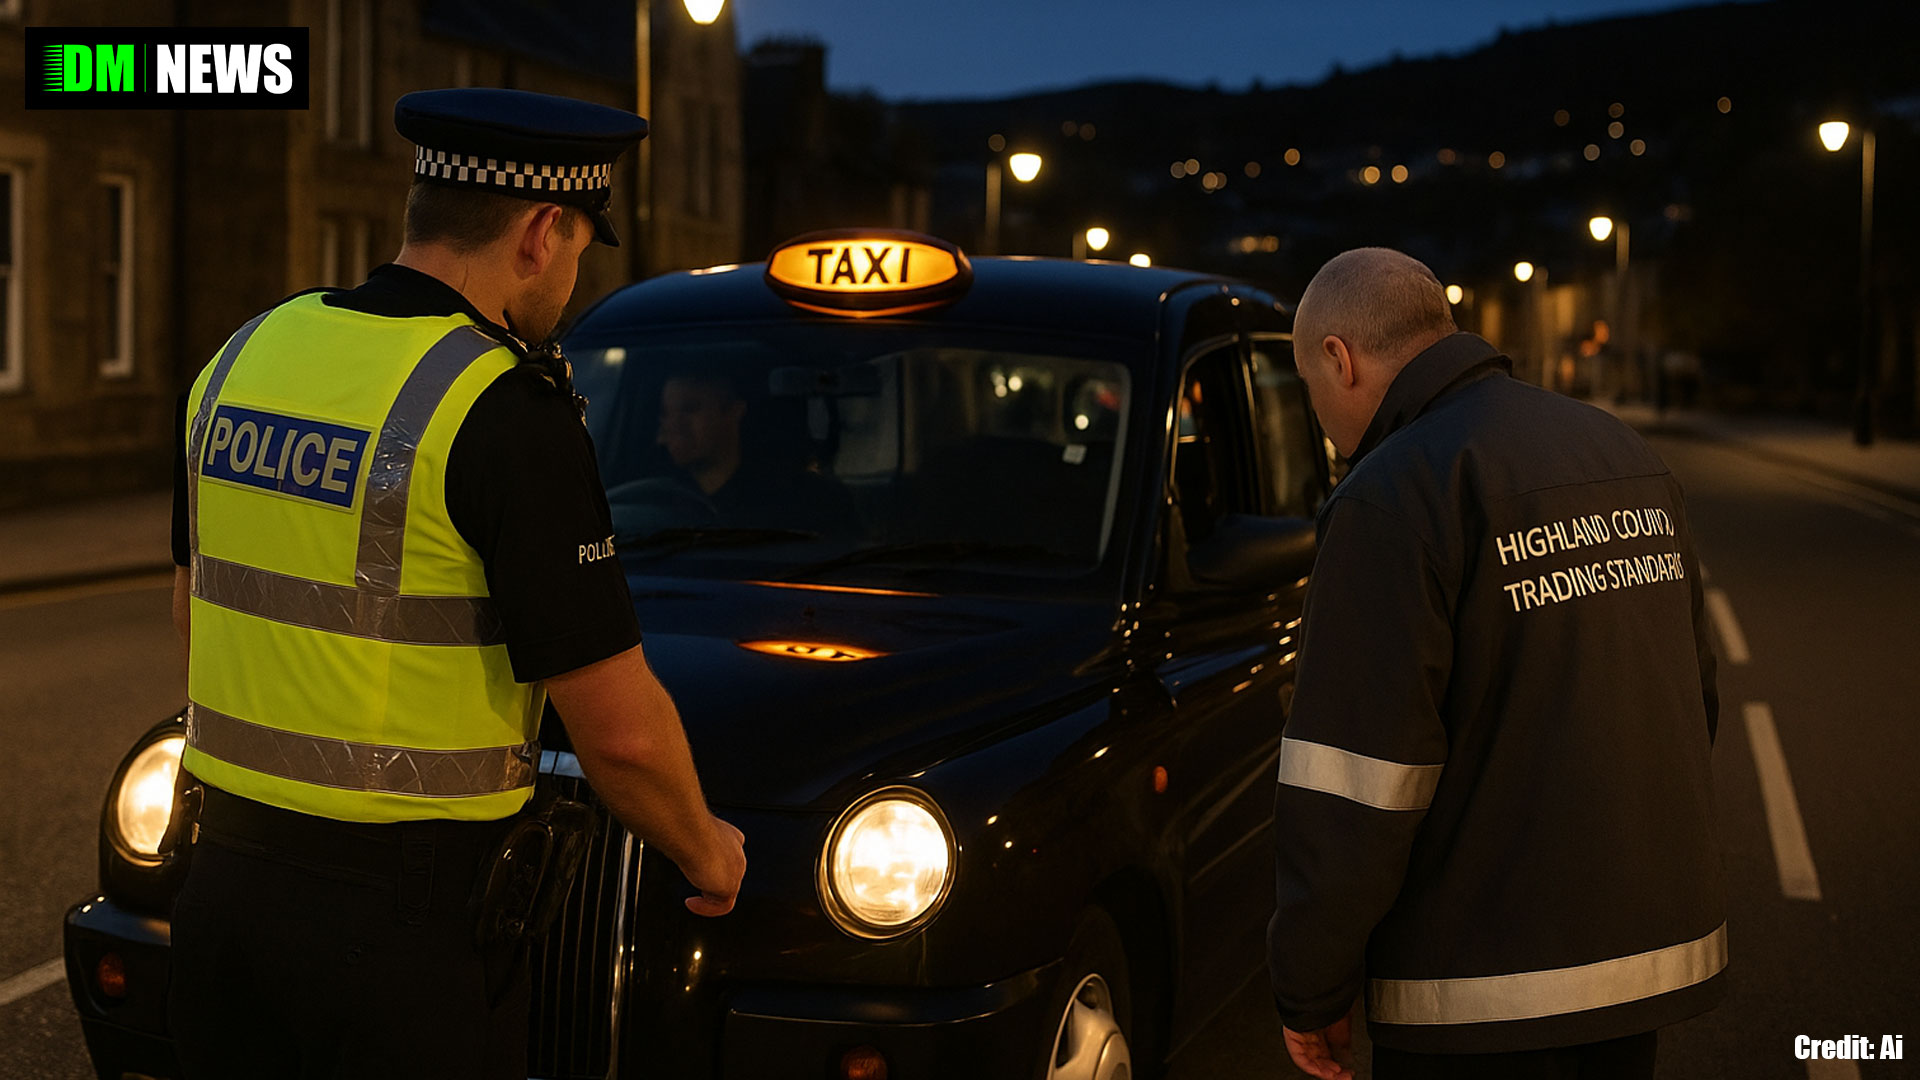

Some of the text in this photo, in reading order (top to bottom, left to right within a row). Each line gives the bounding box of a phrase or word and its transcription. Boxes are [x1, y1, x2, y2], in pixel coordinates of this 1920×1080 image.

[807, 247, 911, 284] TAXI
[206, 416, 359, 494] POLICE
[1495, 513, 1611, 566] HIGHLAND
[1503, 562, 1608, 612] TRADING
